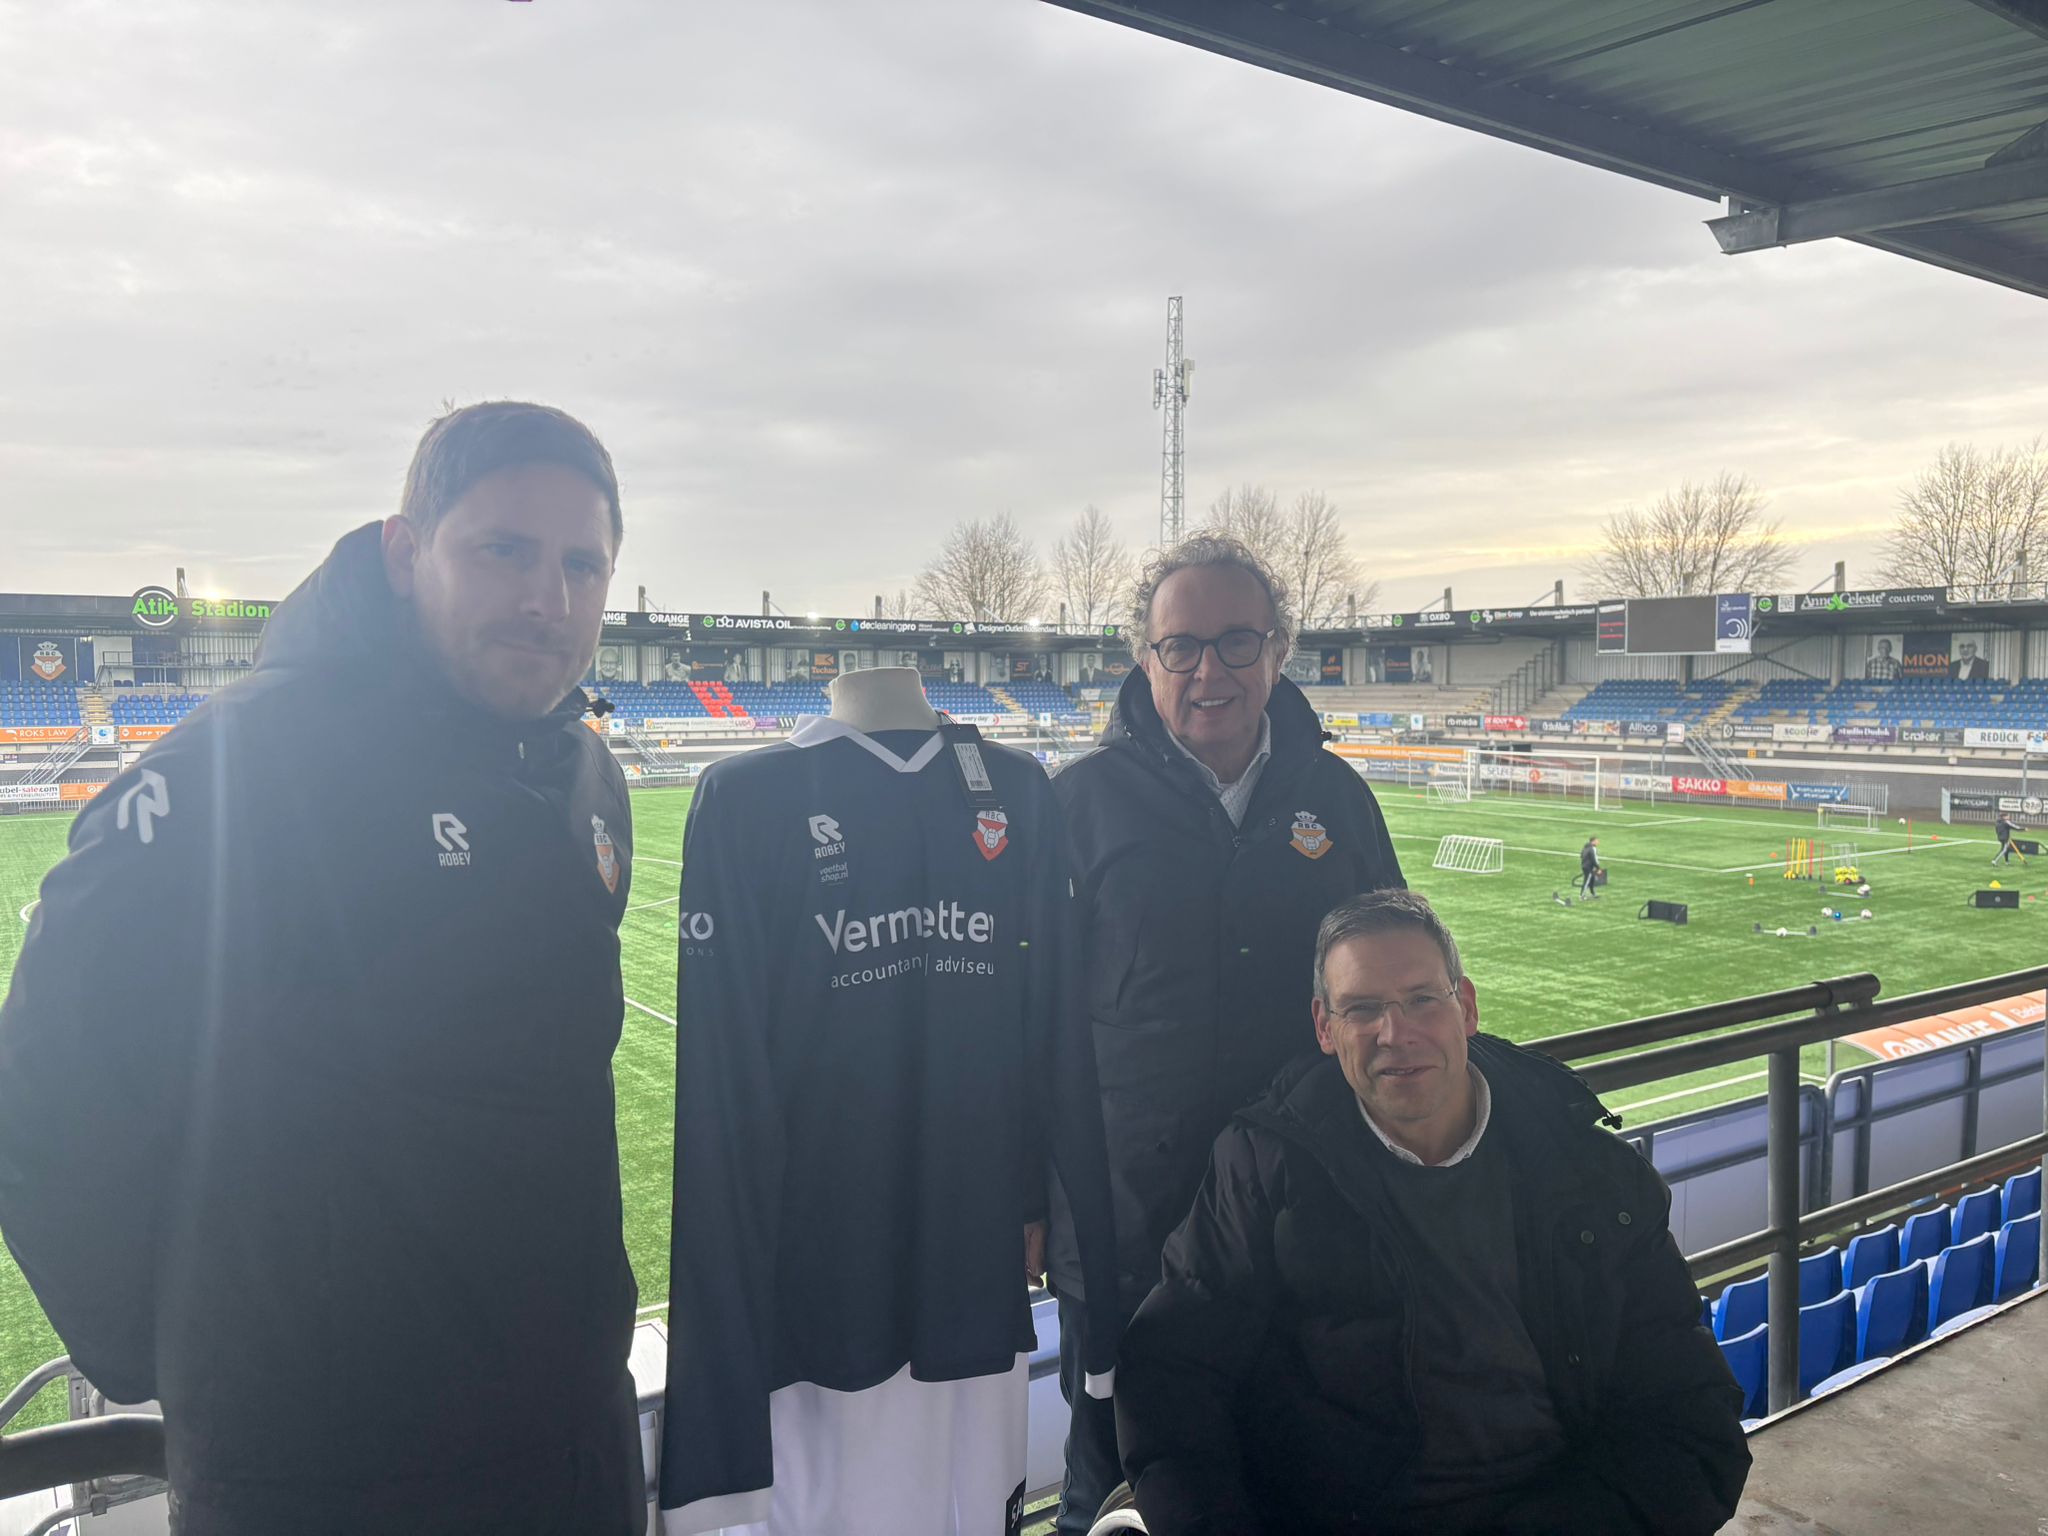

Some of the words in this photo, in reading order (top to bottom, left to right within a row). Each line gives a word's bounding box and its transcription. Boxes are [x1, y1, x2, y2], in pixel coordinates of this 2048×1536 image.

[1889, 594, 1934, 603] COLLECTION
[132, 598, 178, 615] Atik
[191, 599, 270, 618] Stadion
[648, 613, 690, 624] ORANGE
[735, 619, 775, 630] AVISTA
[775, 620, 793, 630] OIL
[978, 624, 1004, 633] Designer
[1004, 625, 1024, 633] Outlet
[1904, 654, 1949, 666] MION
[19, 729, 45, 737] ROKS
[1678, 778, 1721, 792] SAKKO
[814, 841, 846, 860] ROBEY
[438, 852, 471, 867] ROBEY
